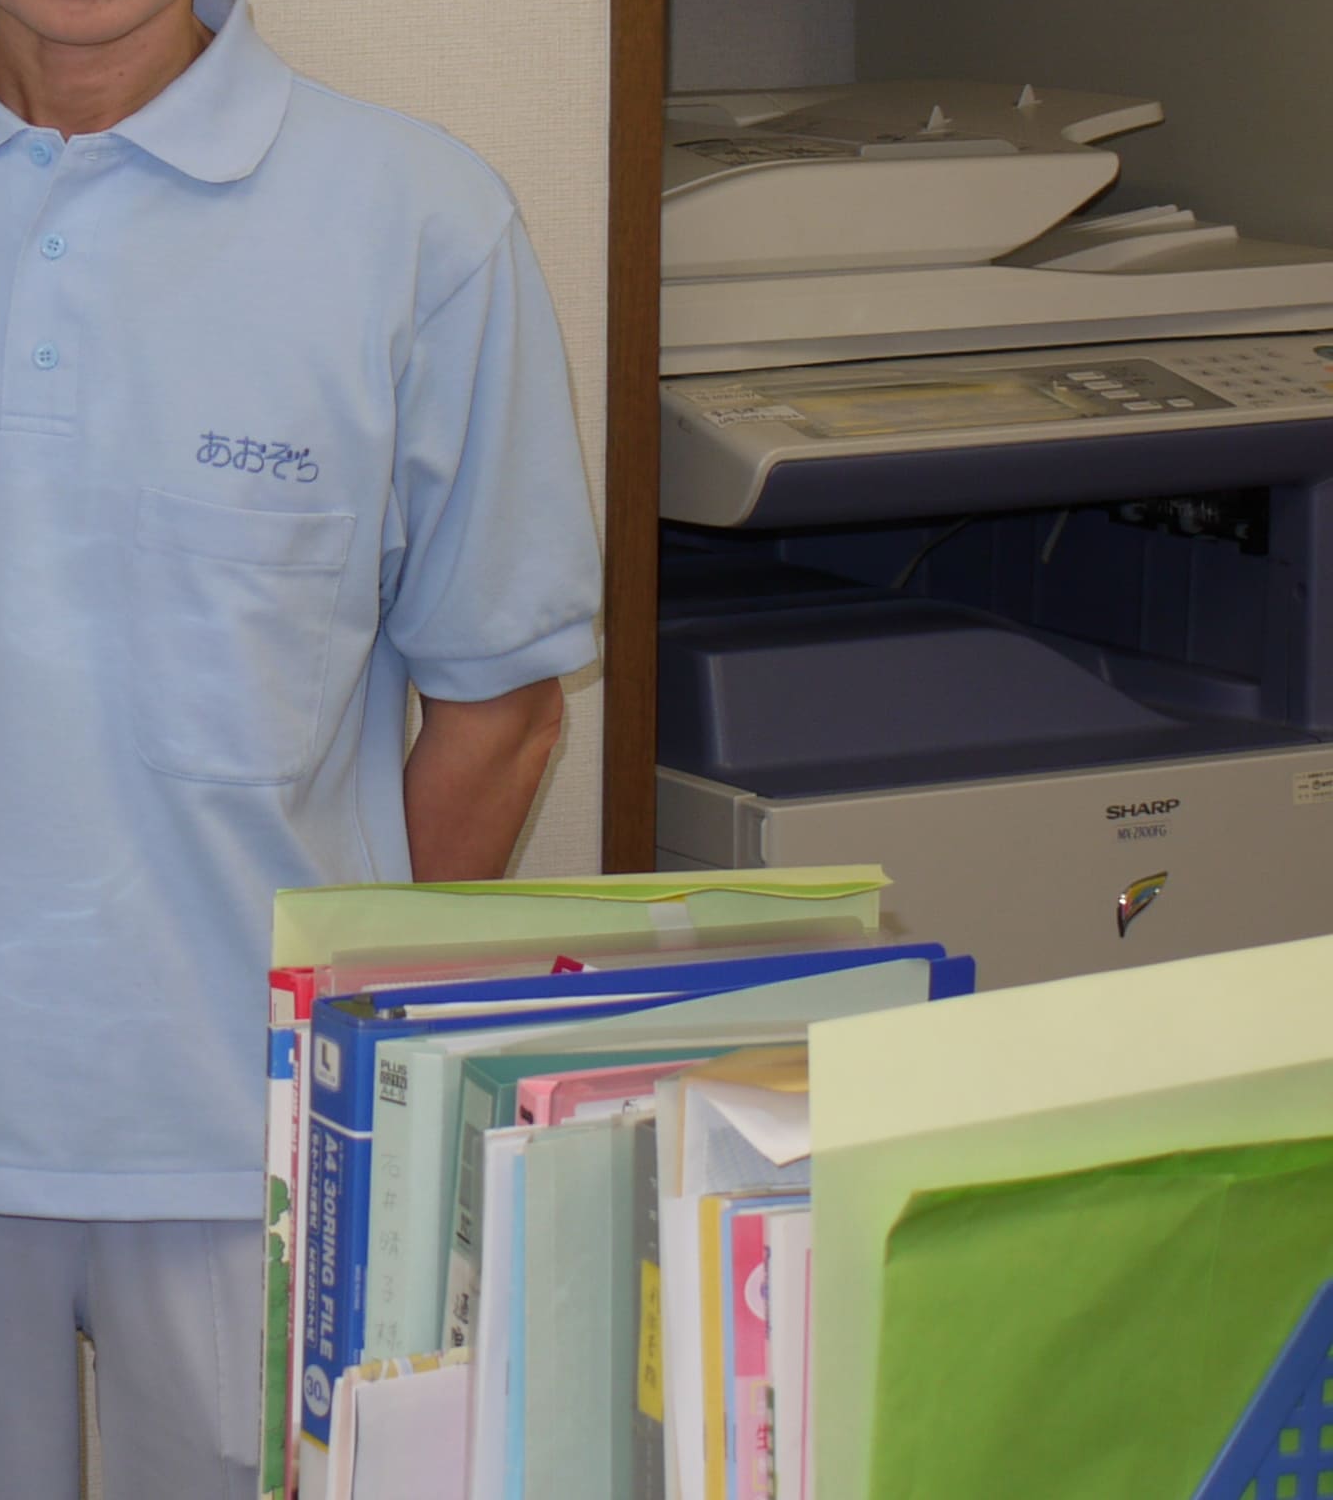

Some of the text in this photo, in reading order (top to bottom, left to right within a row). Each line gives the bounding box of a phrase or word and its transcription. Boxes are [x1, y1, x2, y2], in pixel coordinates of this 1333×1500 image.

[196, 430, 319, 483] あおぞら
[1105, 798, 1180, 820] SHARP
[380, 1059, 407, 1076] PLUS
[320, 1131, 338, 1361] A4 30RING FILE
